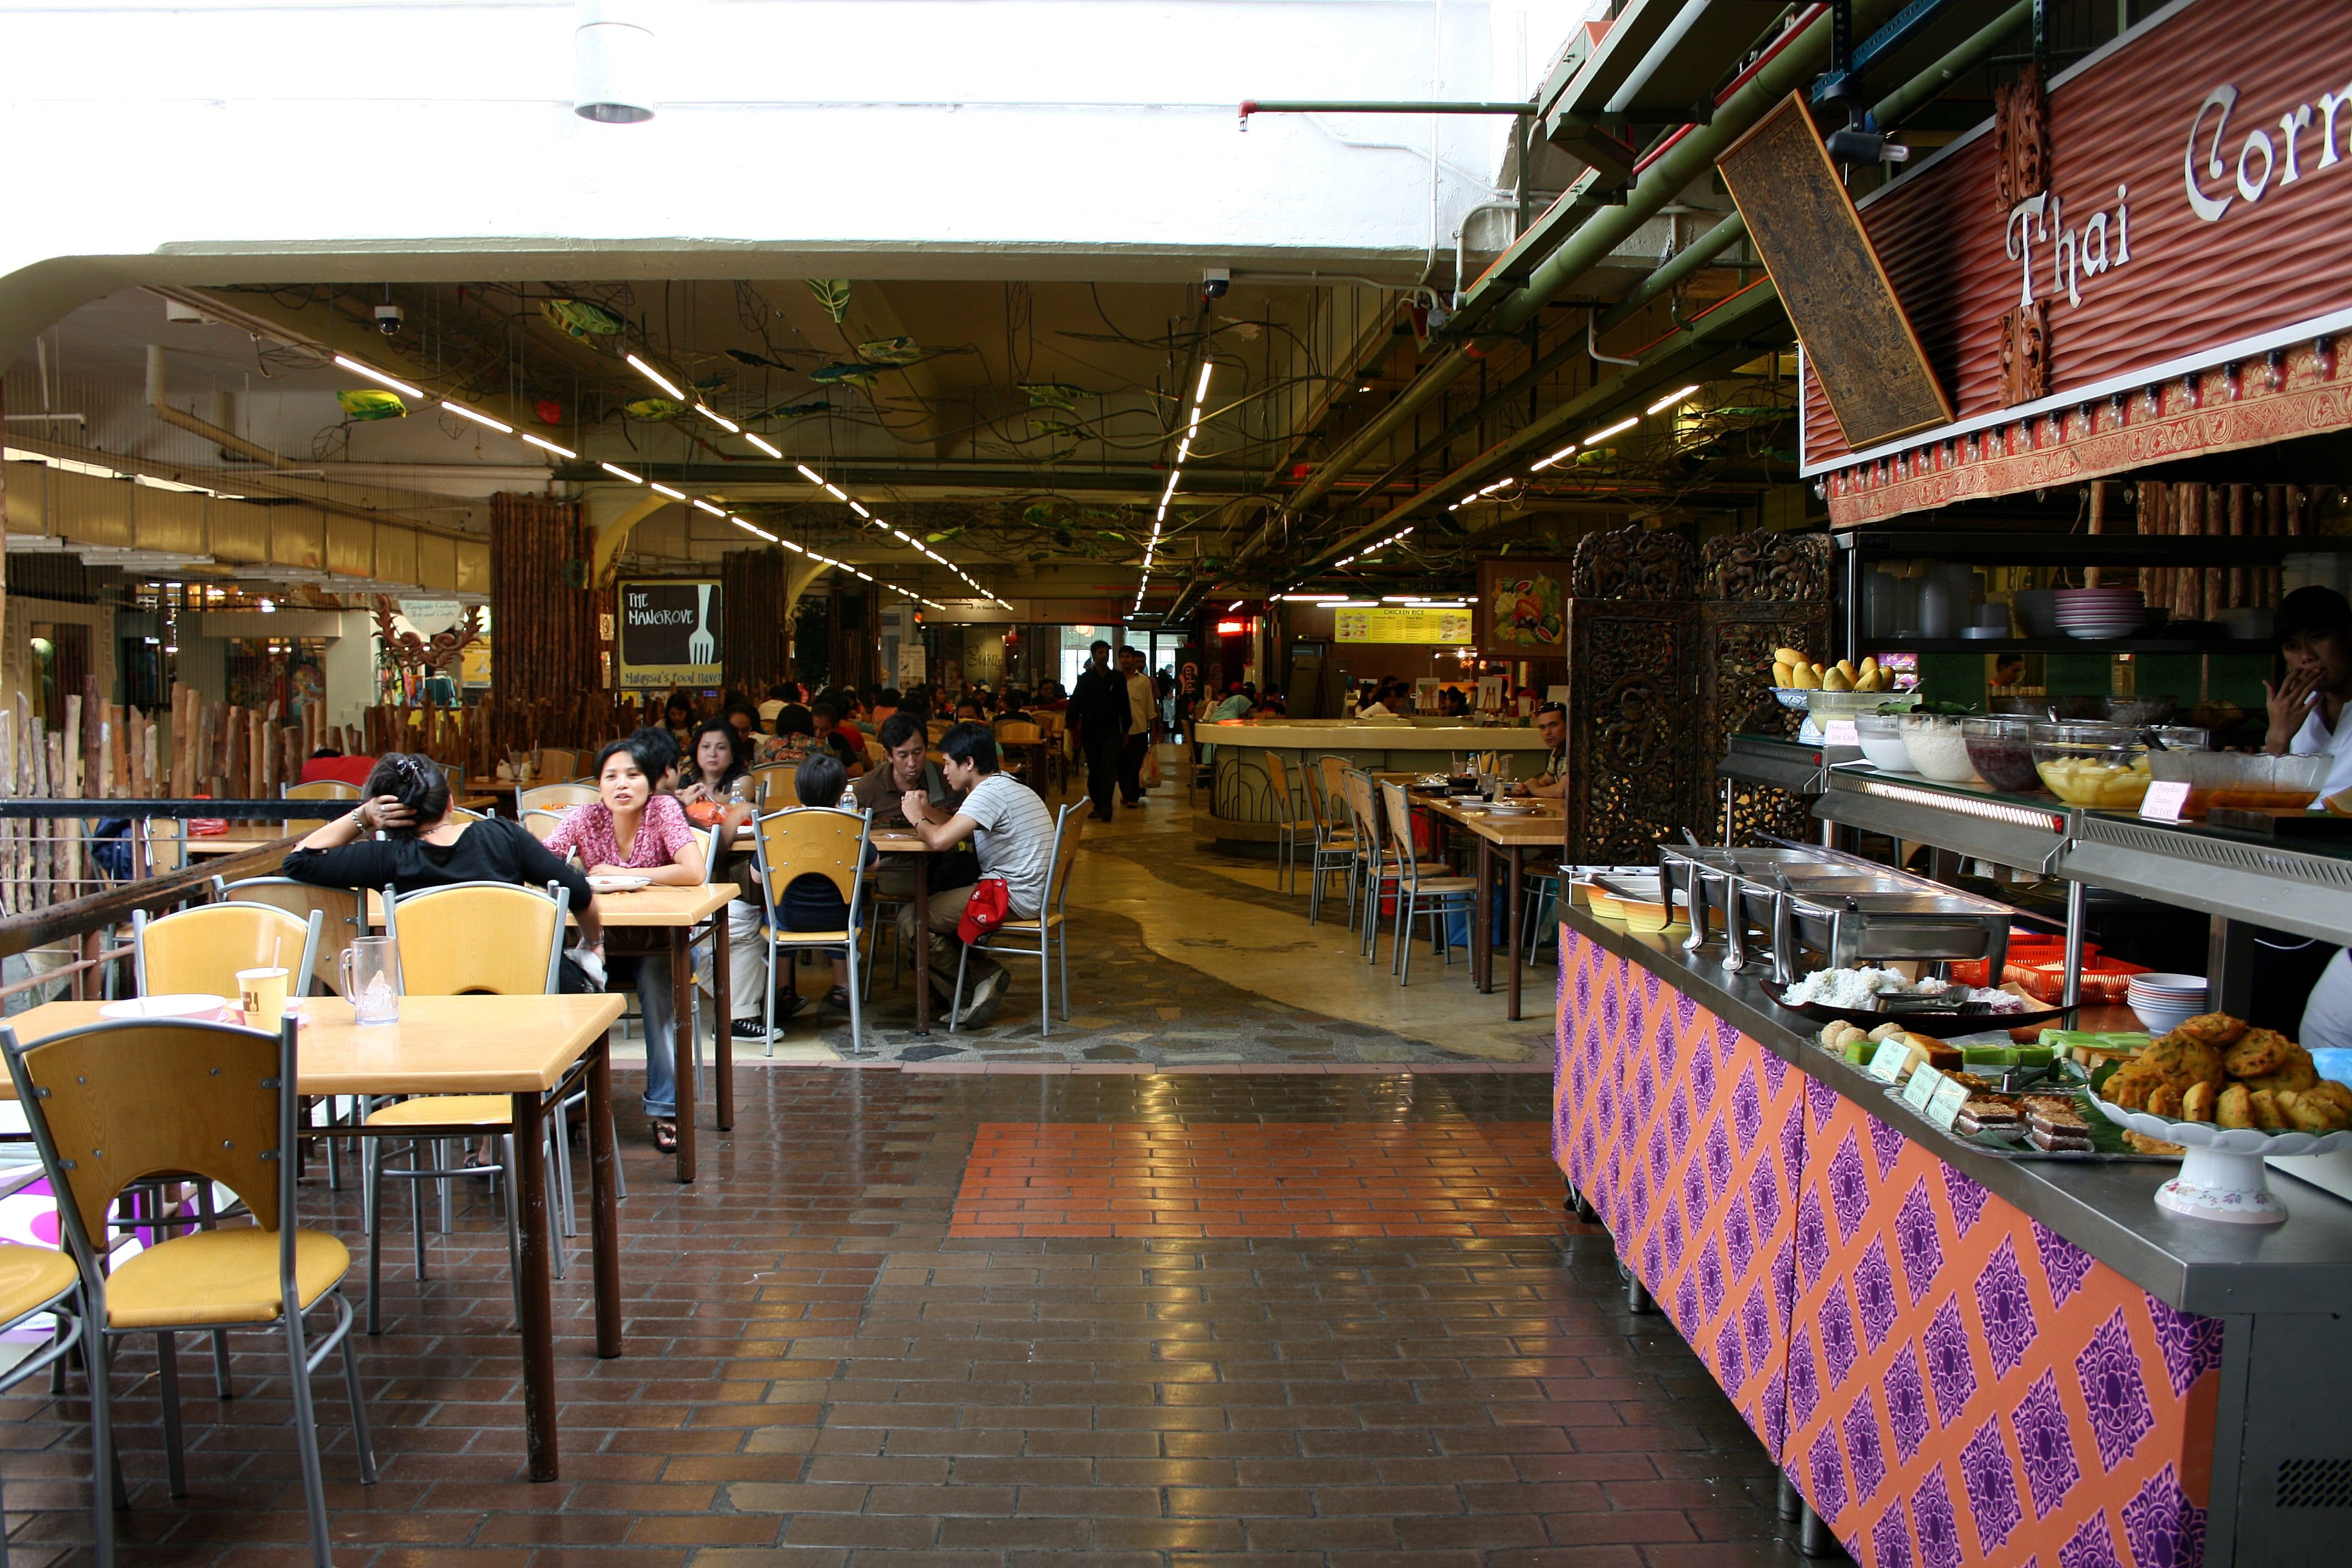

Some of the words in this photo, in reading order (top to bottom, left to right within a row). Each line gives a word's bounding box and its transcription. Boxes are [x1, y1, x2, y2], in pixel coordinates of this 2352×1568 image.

[2006, 184, 2130, 309] Thai
[628, 593, 649, 609] THE
[629, 609, 694, 626] MANGROVE
[626, 671, 669, 685] Malaysia's
